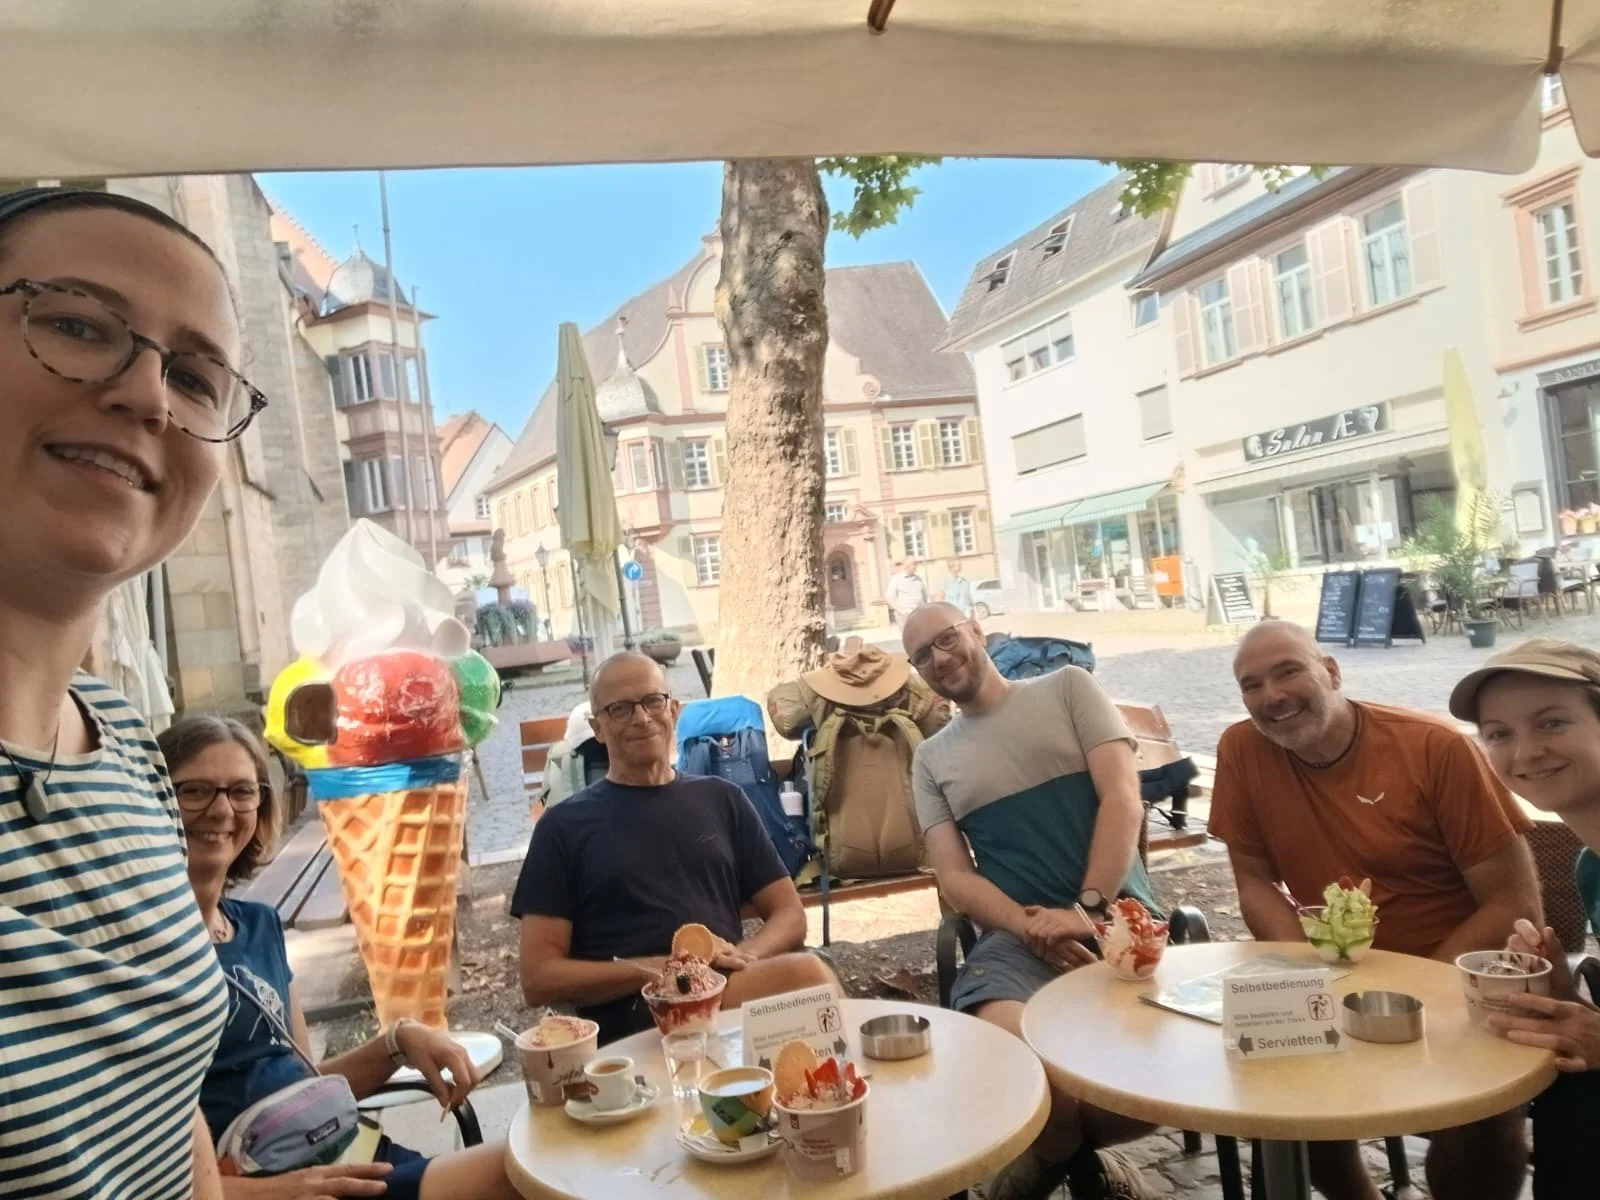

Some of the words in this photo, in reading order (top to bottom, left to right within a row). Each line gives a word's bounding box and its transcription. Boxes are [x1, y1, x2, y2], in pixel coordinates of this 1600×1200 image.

[1231, 979, 1325, 994] Selbstbedienung
[749, 992, 831, 1018] Selbstbedienung
[1257, 1034, 1322, 1050] Servietten
